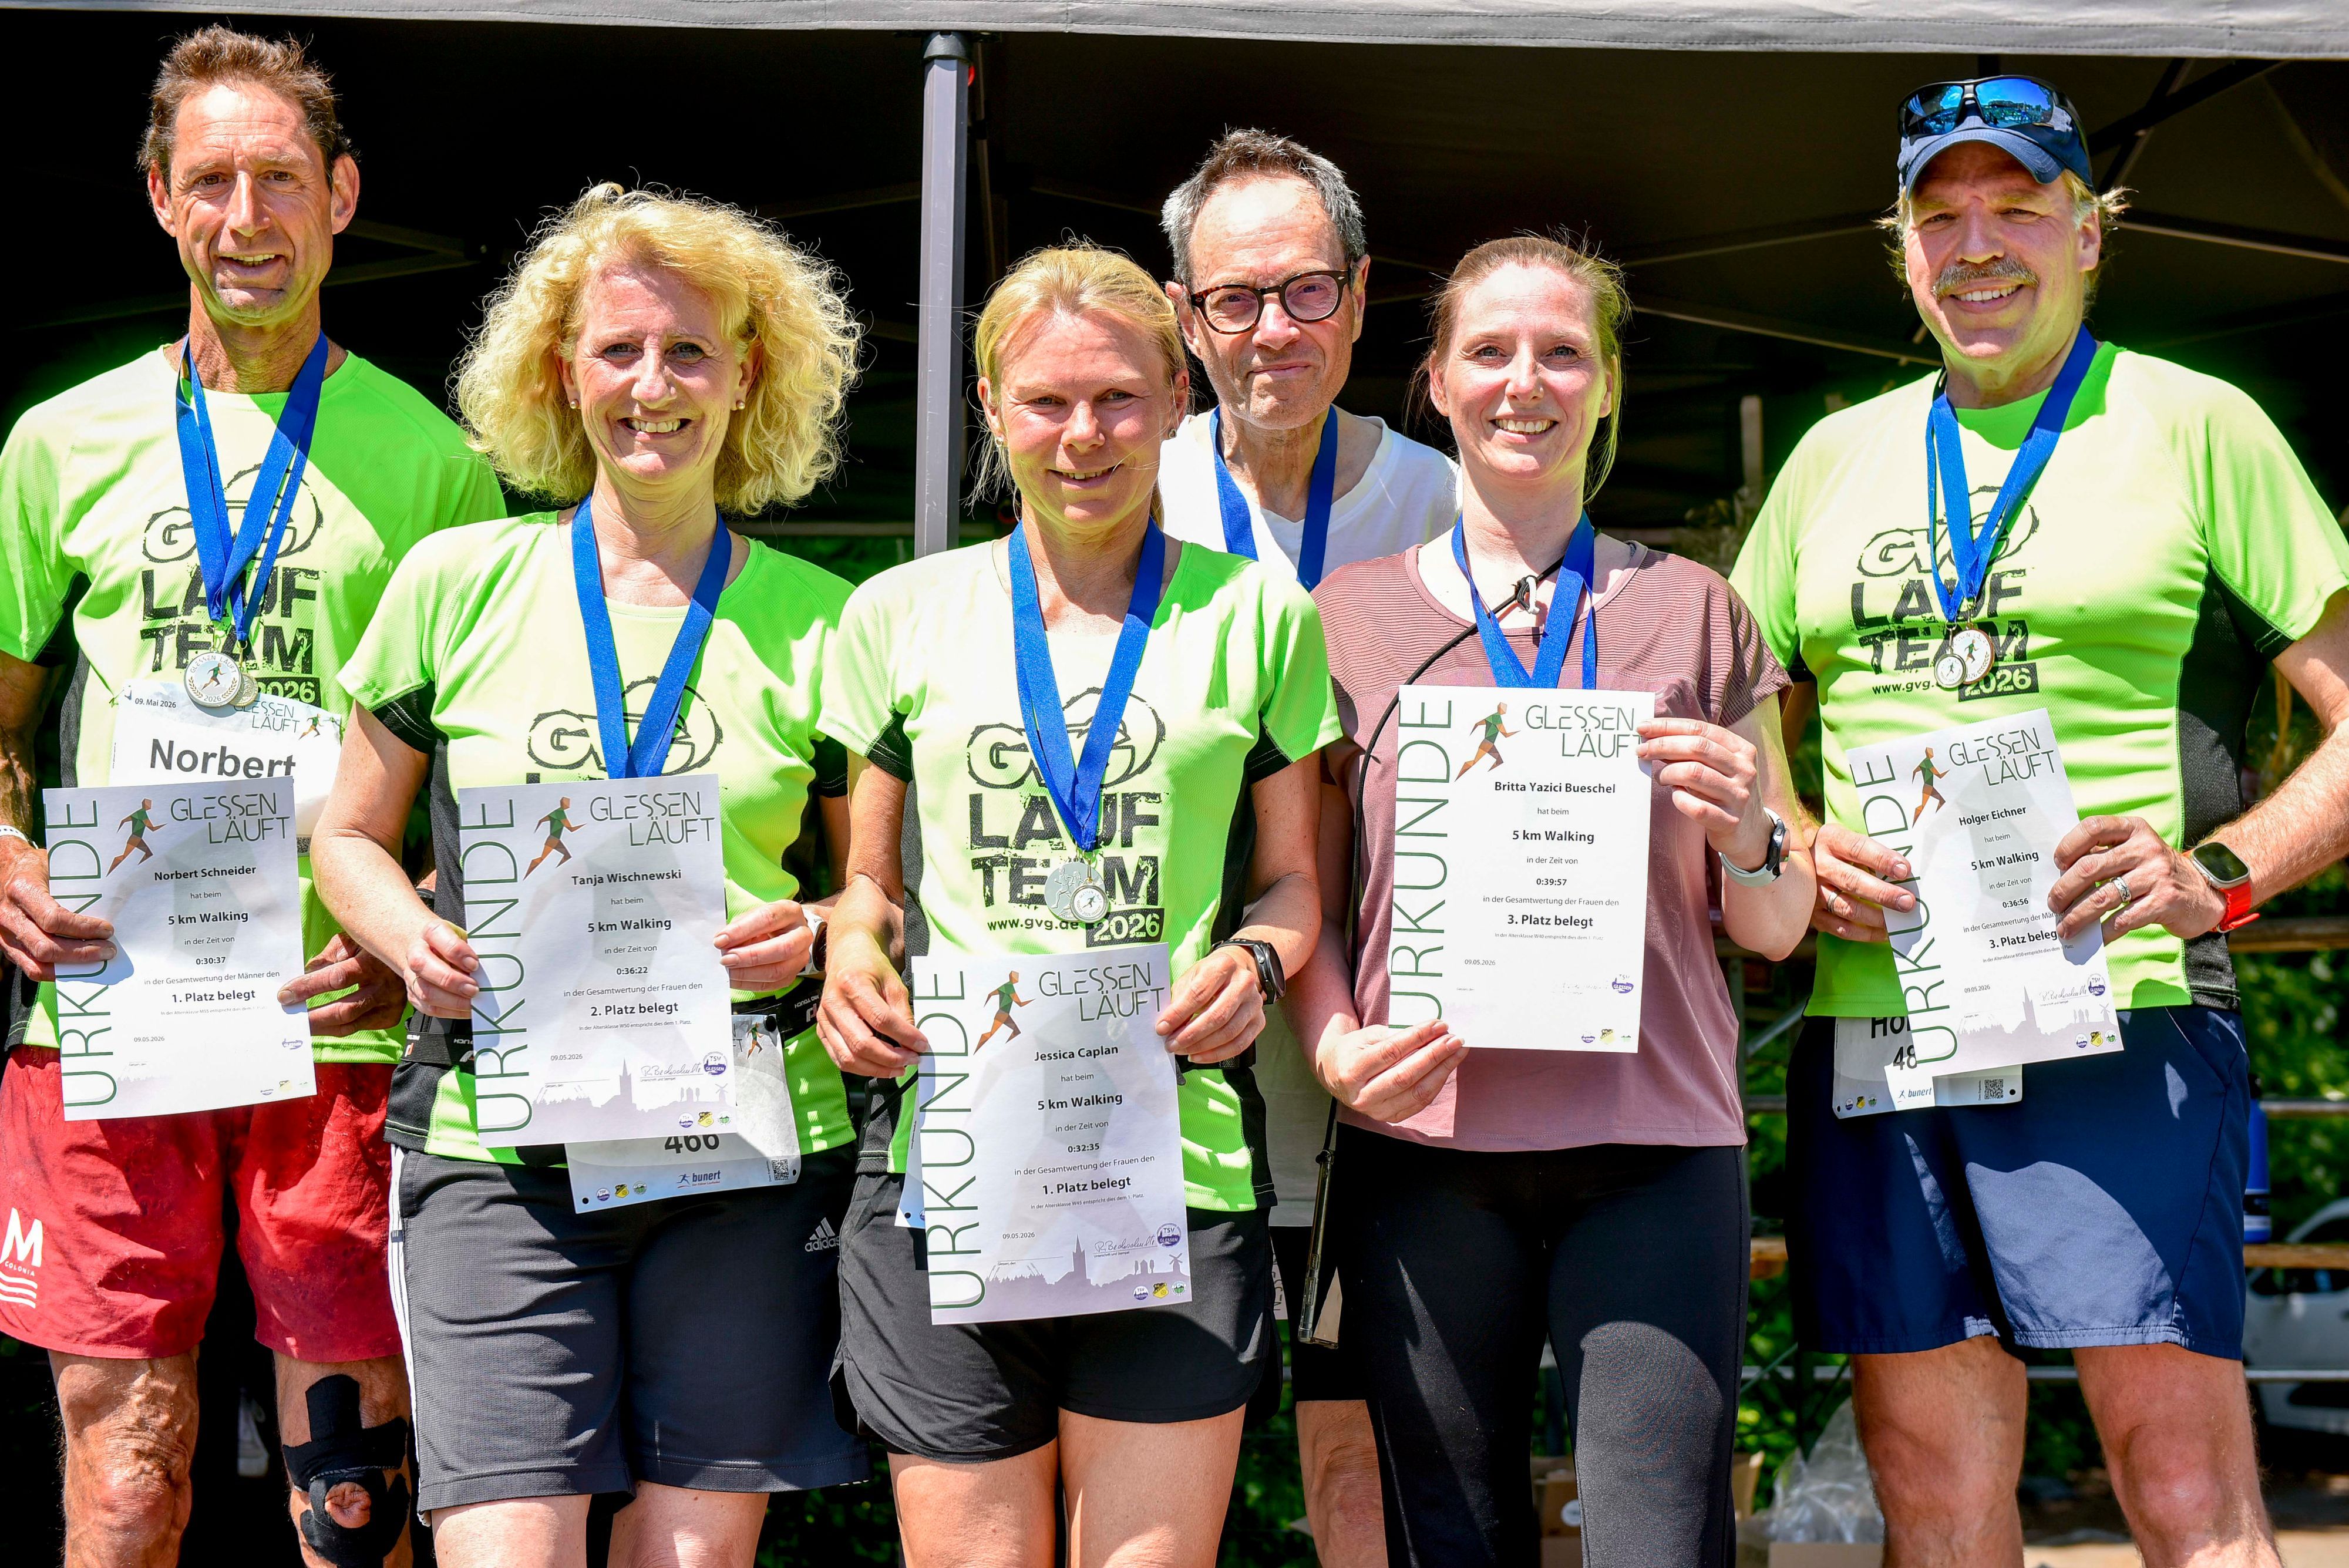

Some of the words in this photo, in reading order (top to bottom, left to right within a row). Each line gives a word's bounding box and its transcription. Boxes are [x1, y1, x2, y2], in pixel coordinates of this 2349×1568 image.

[146, 699, 159, 707] Mai
[160, 700, 177, 709] 2026
[252, 712, 300, 733] LÄUFT
[1525, 705, 1635, 731] GLESSEN
[1949, 726, 2041, 767] GLESSEN
[150, 738, 296, 779] Norbert
[1983, 749, 2056, 787] LÄUFT
[1495, 782, 1526, 792] Britta
[1529, 782, 1562, 792] Yazici
[1565, 783, 1616, 793] Bueschel
[170, 793, 278, 822] GLESSEN
[590, 792, 702, 822] GLESSEN
[1537, 807, 1549, 815] hat
[1958, 814, 1990, 826] Holger
[1991, 807, 2026, 820] Eichner
[208, 815, 291, 845] LÄUFT
[630, 816, 716, 847] LÄUFT
[1512, 830, 1519, 840] 5
[1523, 830, 1542, 840] km
[1544, 830, 1594, 844] Walking
[1388, 700, 1453, 1029] URKUNDE
[1971, 861, 1978, 871] 5
[1978, 859, 1995, 870] km
[1995, 852, 2040, 866] Walking
[154, 870, 198, 881] Norbert
[201, 865, 257, 877] Schneider
[571, 874, 604, 887] Tanja
[606, 869, 682, 883] Wischnewski
[971, 855, 1159, 908] TEM
[1536, 878, 1567, 886] 0:39:57
[2007, 879, 2020, 887] Zeit
[1505, 896, 1563, 906] Gesamtwertung
[2002, 897, 2029, 909] 0:36:56
[168, 916, 175, 926] 5
[178, 914, 197, 924] km
[199, 911, 248, 923] Walking
[588, 923, 595, 933] 5
[598, 921, 617, 932] km
[620, 918, 672, 931] Walking
[987, 916, 1079, 931] www.gvg.de
[1507, 914, 1518, 924] 3.
[1522, 914, 1552, 926] Platz
[1554, 915, 1593, 930] belegt
[1981, 917, 2030, 930] Gesamtwertung
[1989, 939, 2000, 949] 3.
[2000, 936, 2027, 947] Platz
[2027, 930, 2058, 942] beleg
[196, 956, 226, 965] 0:30:37
[458, 799, 533, 1135] URKUNDE
[616, 966, 648, 975] 0:36:22
[166, 975, 223, 984] Gesamtwertung
[1038, 962, 1152, 997] GLESSEN
[172, 994, 182, 1003] 1.
[185, 992, 215, 1002] Platz
[217, 990, 256, 1001] belegt
[586, 987, 646, 995] Gesamtwertung
[1964, 984, 1991, 994] 09.05.2026
[591, 1007, 602, 1017] 2.
[605, 1004, 636, 1015] Platz
[638, 1002, 679, 1015] belegt
[1078, 987, 1166, 1022] LÄUFT
[1034, 1049, 1075, 1062] Jessica
[1078, 1045, 1119, 1059] Caplan
[1075, 1073, 1094, 1081] beim
[1908, 1087, 1933, 1098] bunert
[1038, 1100, 1045, 1111] 5
[1048, 1099, 1068, 1110] km
[1071, 1093, 1123, 1108] Walking
[1064, 1123, 1077, 1132] der
[1078, 1122, 1093, 1130] Zeit
[913, 970, 986, 1310] URKUNDE
[1068, 1143, 1100, 1153] 0:32:35
[1037, 1163, 1098, 1174] Gesamtwertung
[1113, 1158, 1139, 1166] Frauen
[692, 1170, 721, 1184] bunert
[1042, 1185, 1054, 1195] 1.
[1056, 1182, 1088, 1194] Platz
[1091, 1176, 1132, 1190] belegt
[1002, 1231, 1035, 1240] 09.05.2026
[805, 1236, 840, 1252] adidas
[4, 1261, 35, 1277] COLONIA
